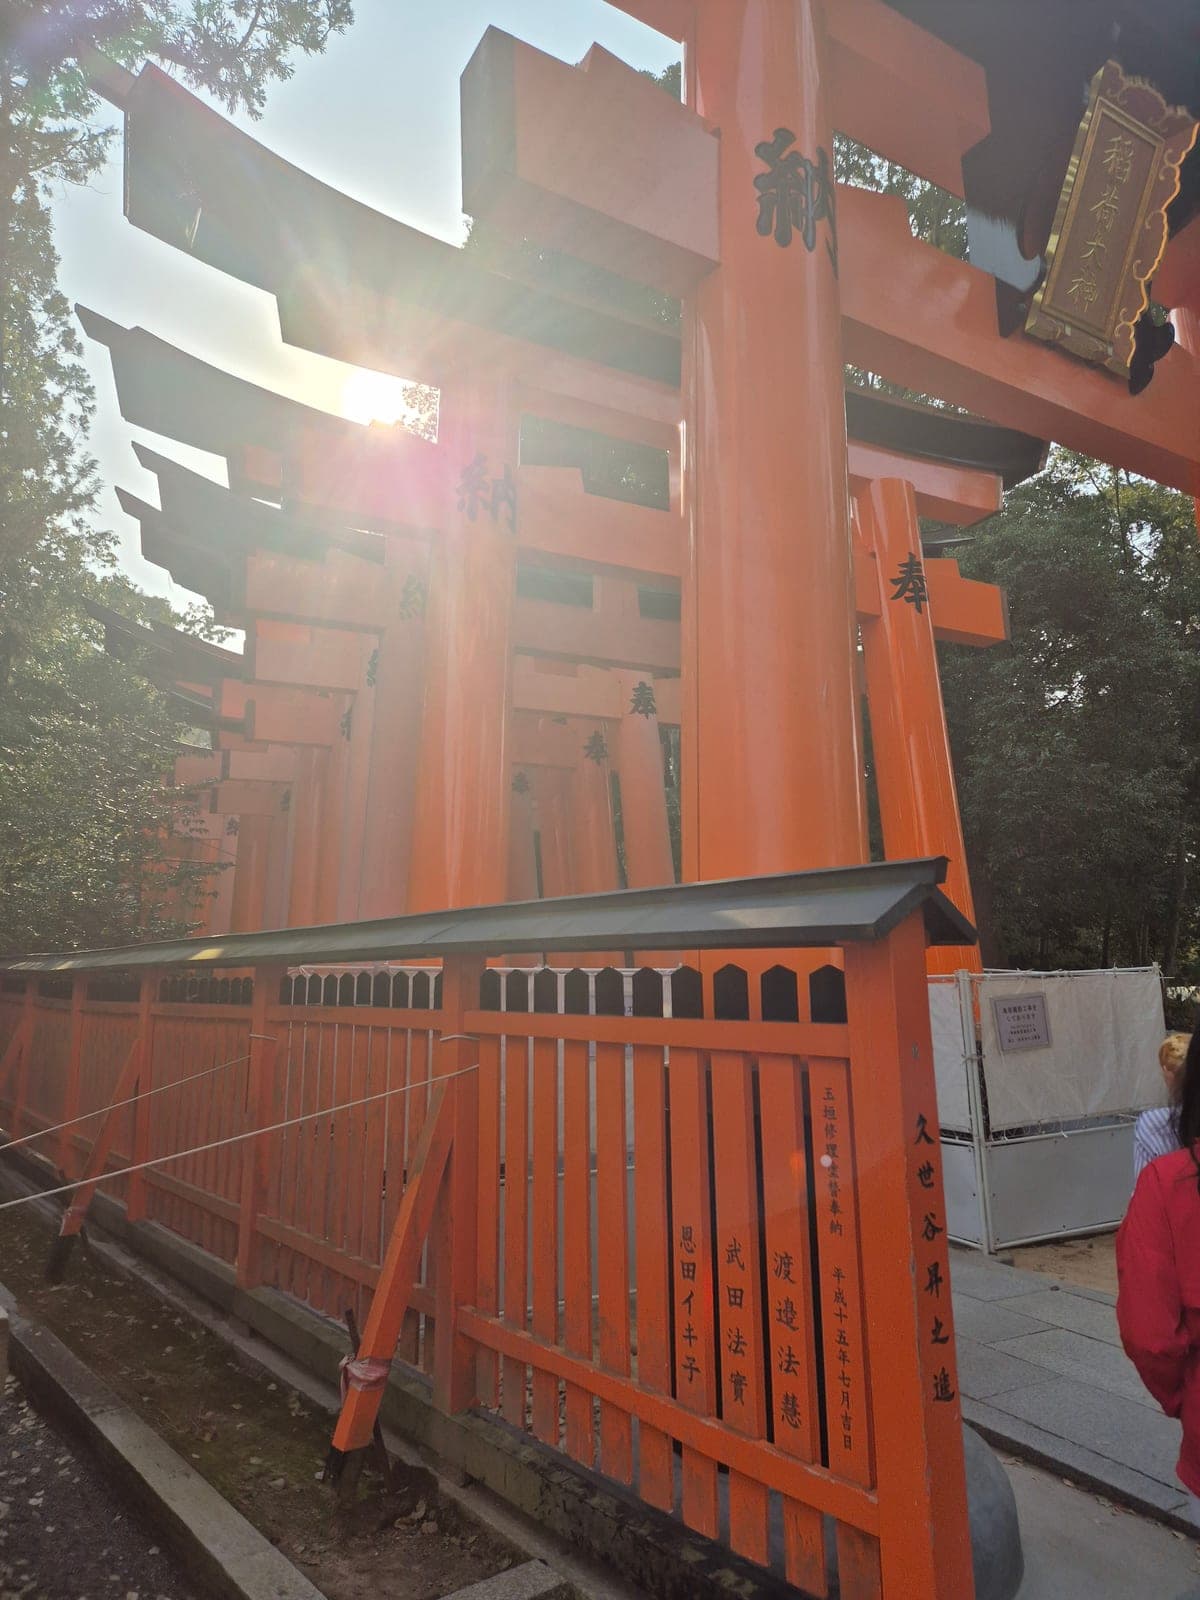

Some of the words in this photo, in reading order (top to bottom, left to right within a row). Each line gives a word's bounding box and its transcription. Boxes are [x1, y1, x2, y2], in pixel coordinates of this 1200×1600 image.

[889, 552, 928, 614] 奉
[629, 681, 657, 720] 奉
[833, 1265, 853, 1451] 平成十五年七月吉日
